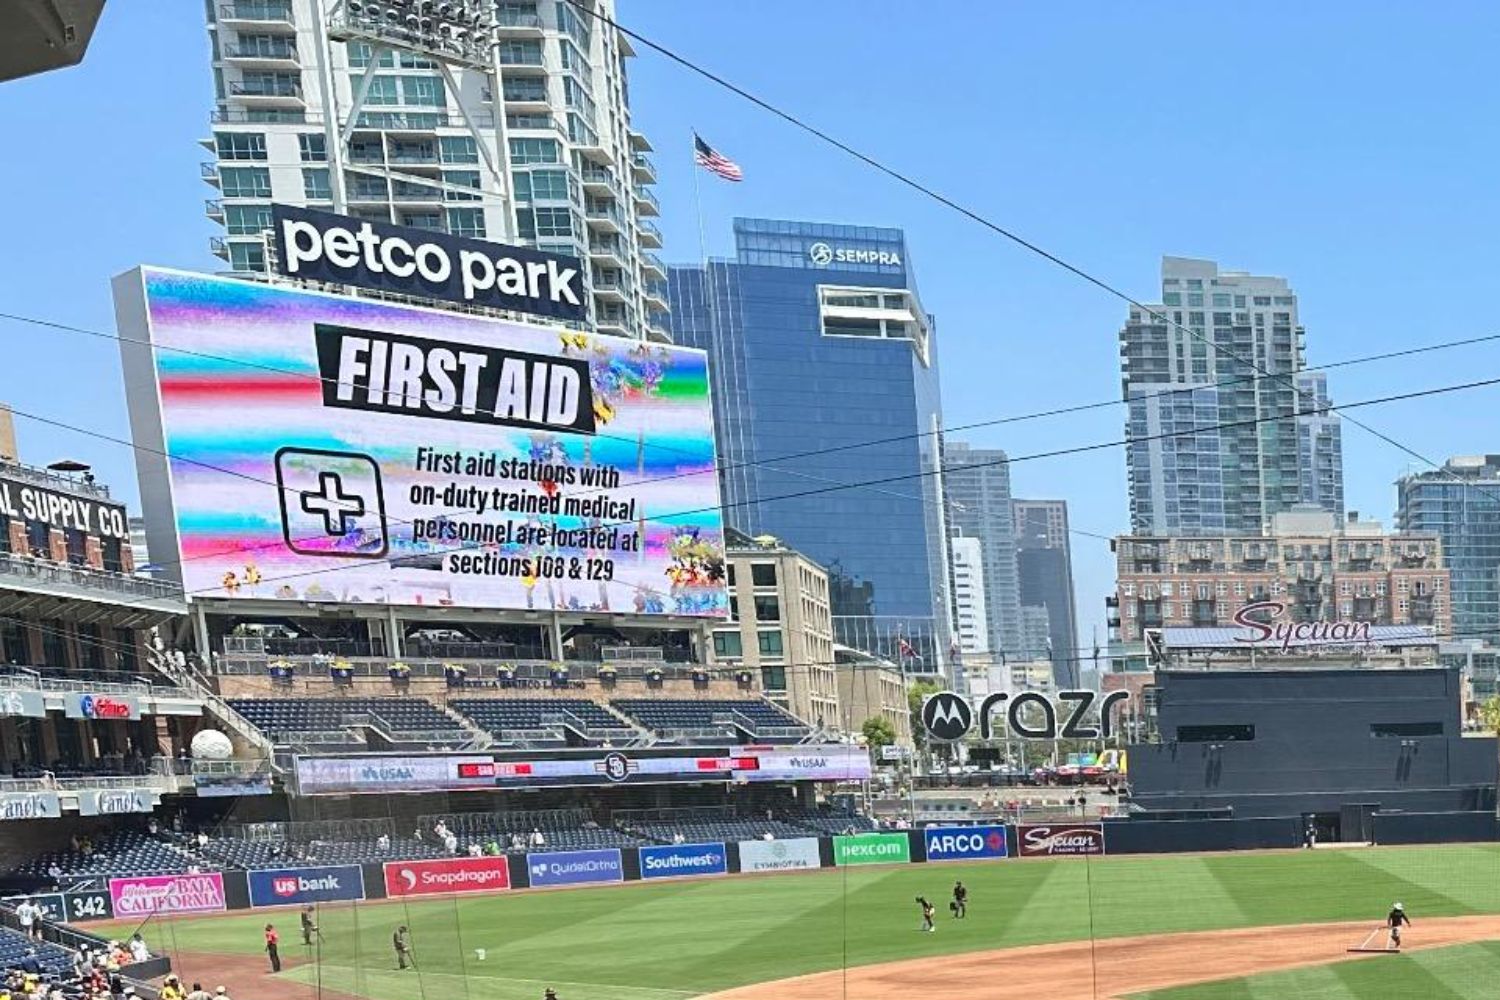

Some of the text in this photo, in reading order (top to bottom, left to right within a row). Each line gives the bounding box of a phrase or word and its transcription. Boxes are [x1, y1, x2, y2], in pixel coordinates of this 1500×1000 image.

[282, 219, 581, 306] petco park
[836, 249, 901, 265] SEMPRA
[337, 335, 581, 427] FIRST AID
[416, 447, 620, 488] First aid stations with
[20, 488, 91, 532] SUPPLY
[98, 506, 129, 540] CO.
[410, 482, 635, 521] on-duty trained medical
[412, 518, 639, 552] personnel are located at
[449, 551, 614, 582] sections 108 & 129
[1233, 602, 1373, 655] Sycuan
[979, 691, 1129, 740] razr
[380, 767, 414, 779] USAA
[803, 758, 827, 769] USAA
[929, 834, 984, 852] ARCO
[1024, 827, 1095, 854] Sycuan
[645, 854, 712, 870] Southwest
[176, 877, 215, 894] BAJA
[421, 869, 501, 886] Snapdragon
[73, 896, 106, 917] 342
[117, 894, 222, 912] CALIFORNIA
